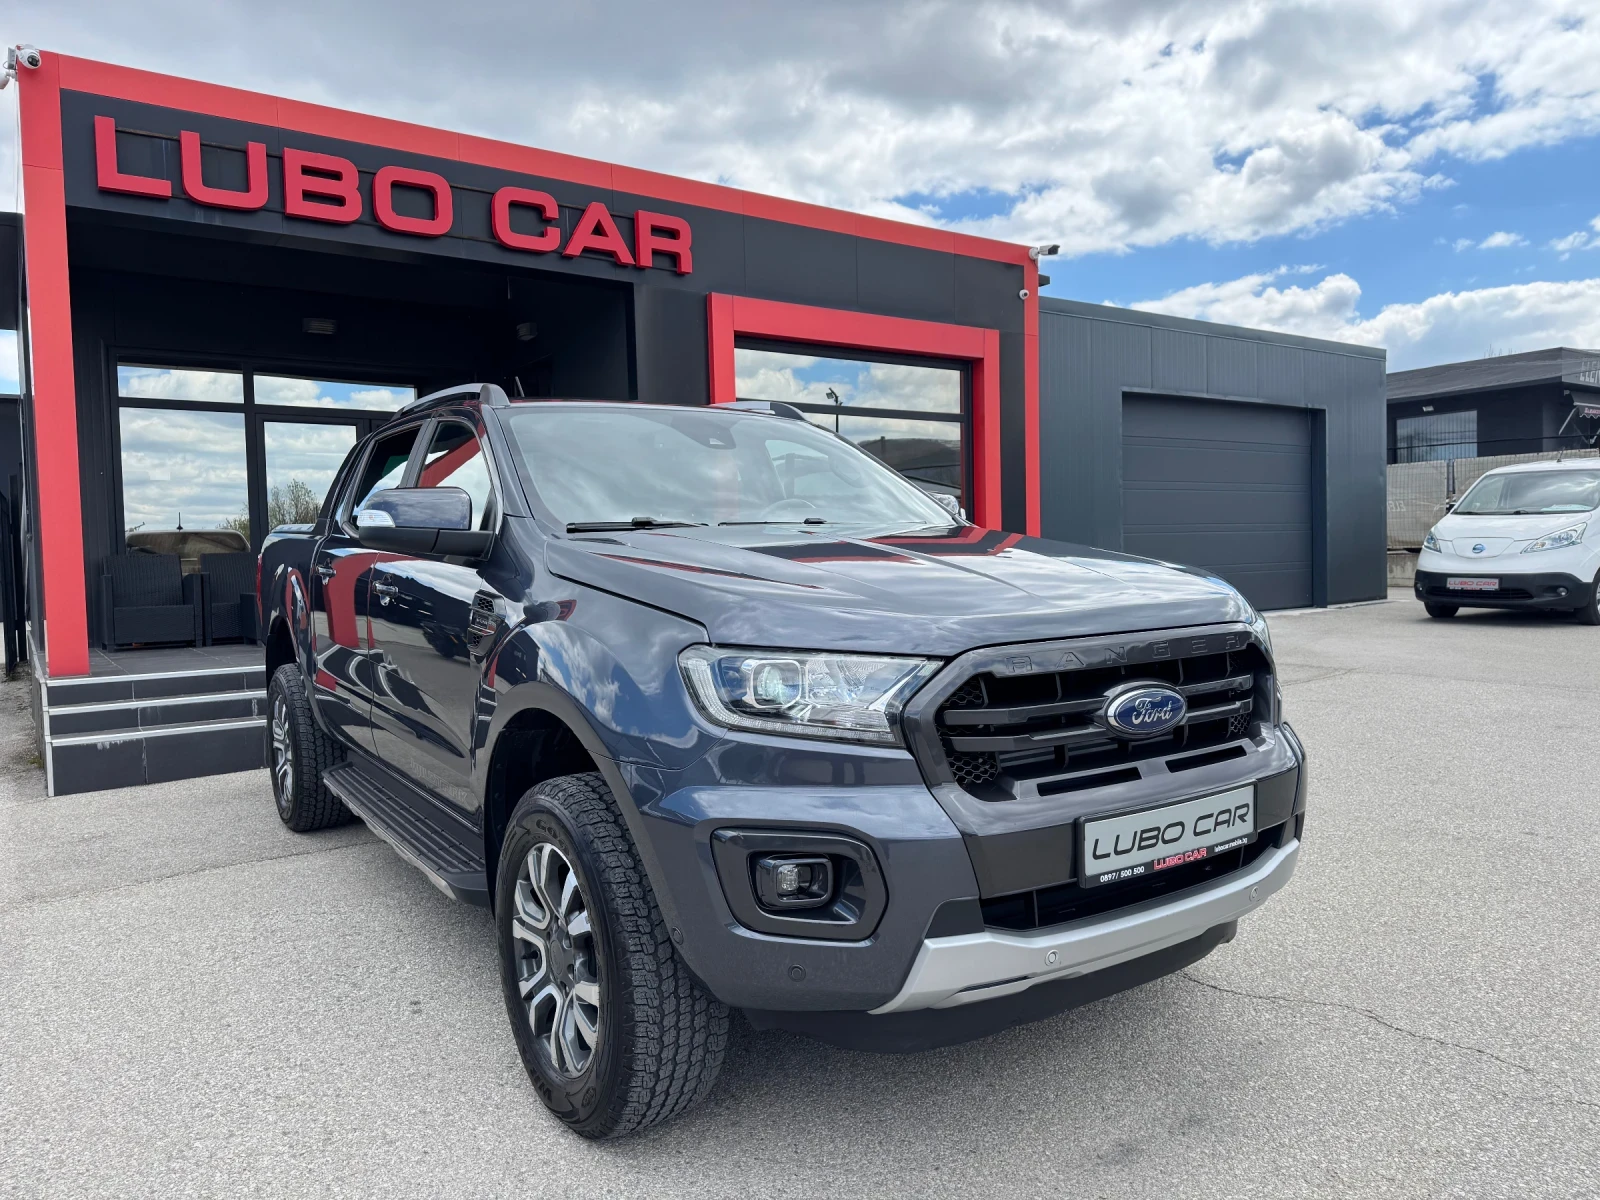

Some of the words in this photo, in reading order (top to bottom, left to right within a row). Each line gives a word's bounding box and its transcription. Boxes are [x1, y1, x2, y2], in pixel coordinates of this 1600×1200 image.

[94, 115, 454, 237] LUBO
[492, 186, 693, 275] CAR
[1004, 635, 1241, 673] RANGER
[1132, 696, 1172, 725] Ford
[1092, 820, 1186, 861] LUBO
[1193, 802, 1250, 837] CAR
[1120, 868, 1132, 878] 500
[1133, 865, 1145, 875] 500
[1153, 854, 1184, 871] LUBO
[1184, 847, 1207, 862] CAR
